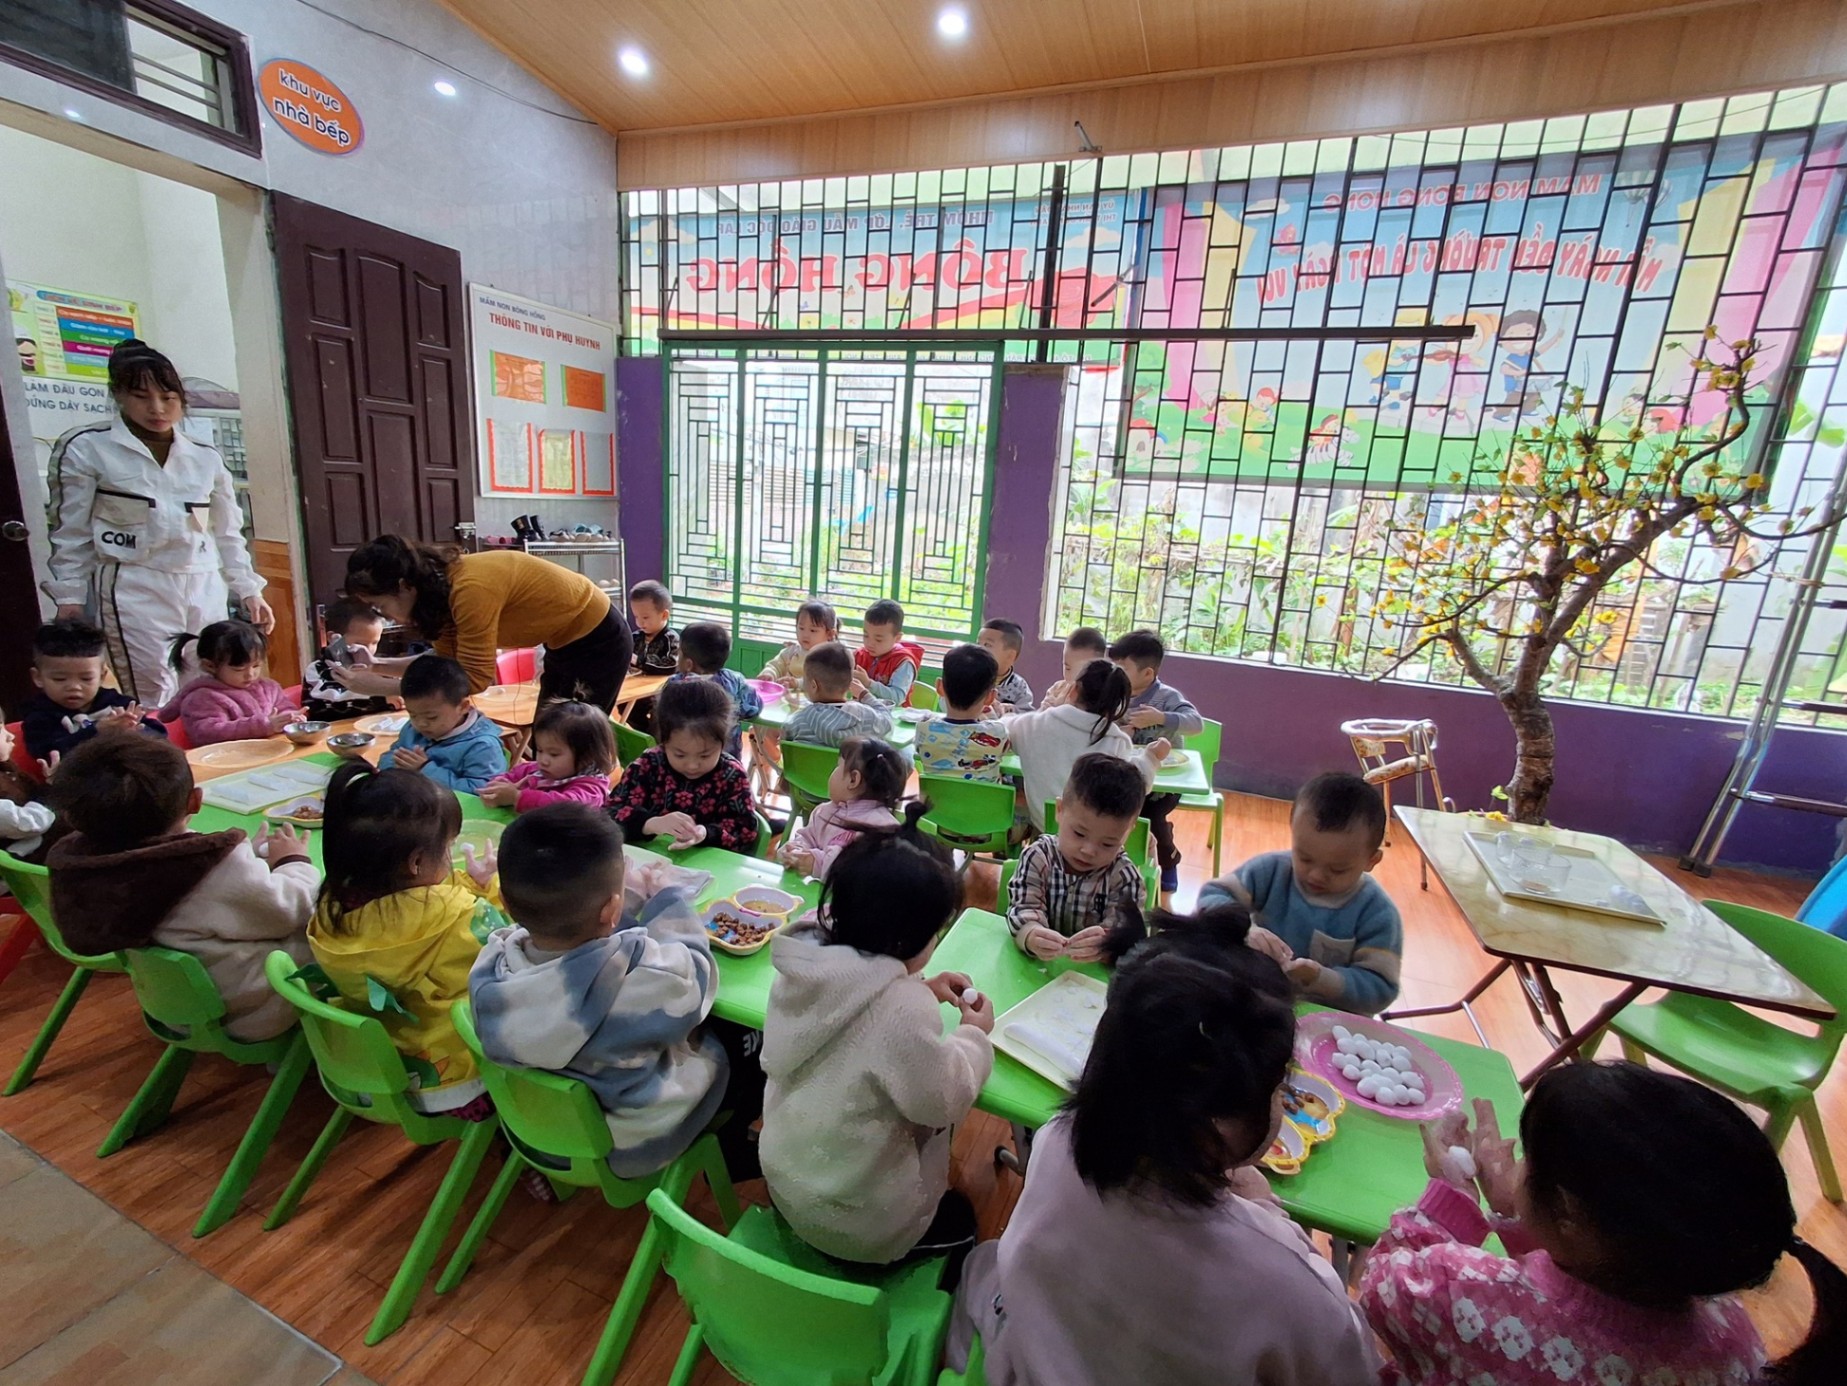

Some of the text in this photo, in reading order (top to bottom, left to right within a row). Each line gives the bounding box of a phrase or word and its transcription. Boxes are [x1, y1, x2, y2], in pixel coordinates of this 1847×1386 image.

[279, 69, 341, 112] khu vực
[274, 98, 350, 146] nhà bếp
[523, 321, 538, 334] TIN
[575, 335, 601, 350] HUYNH
